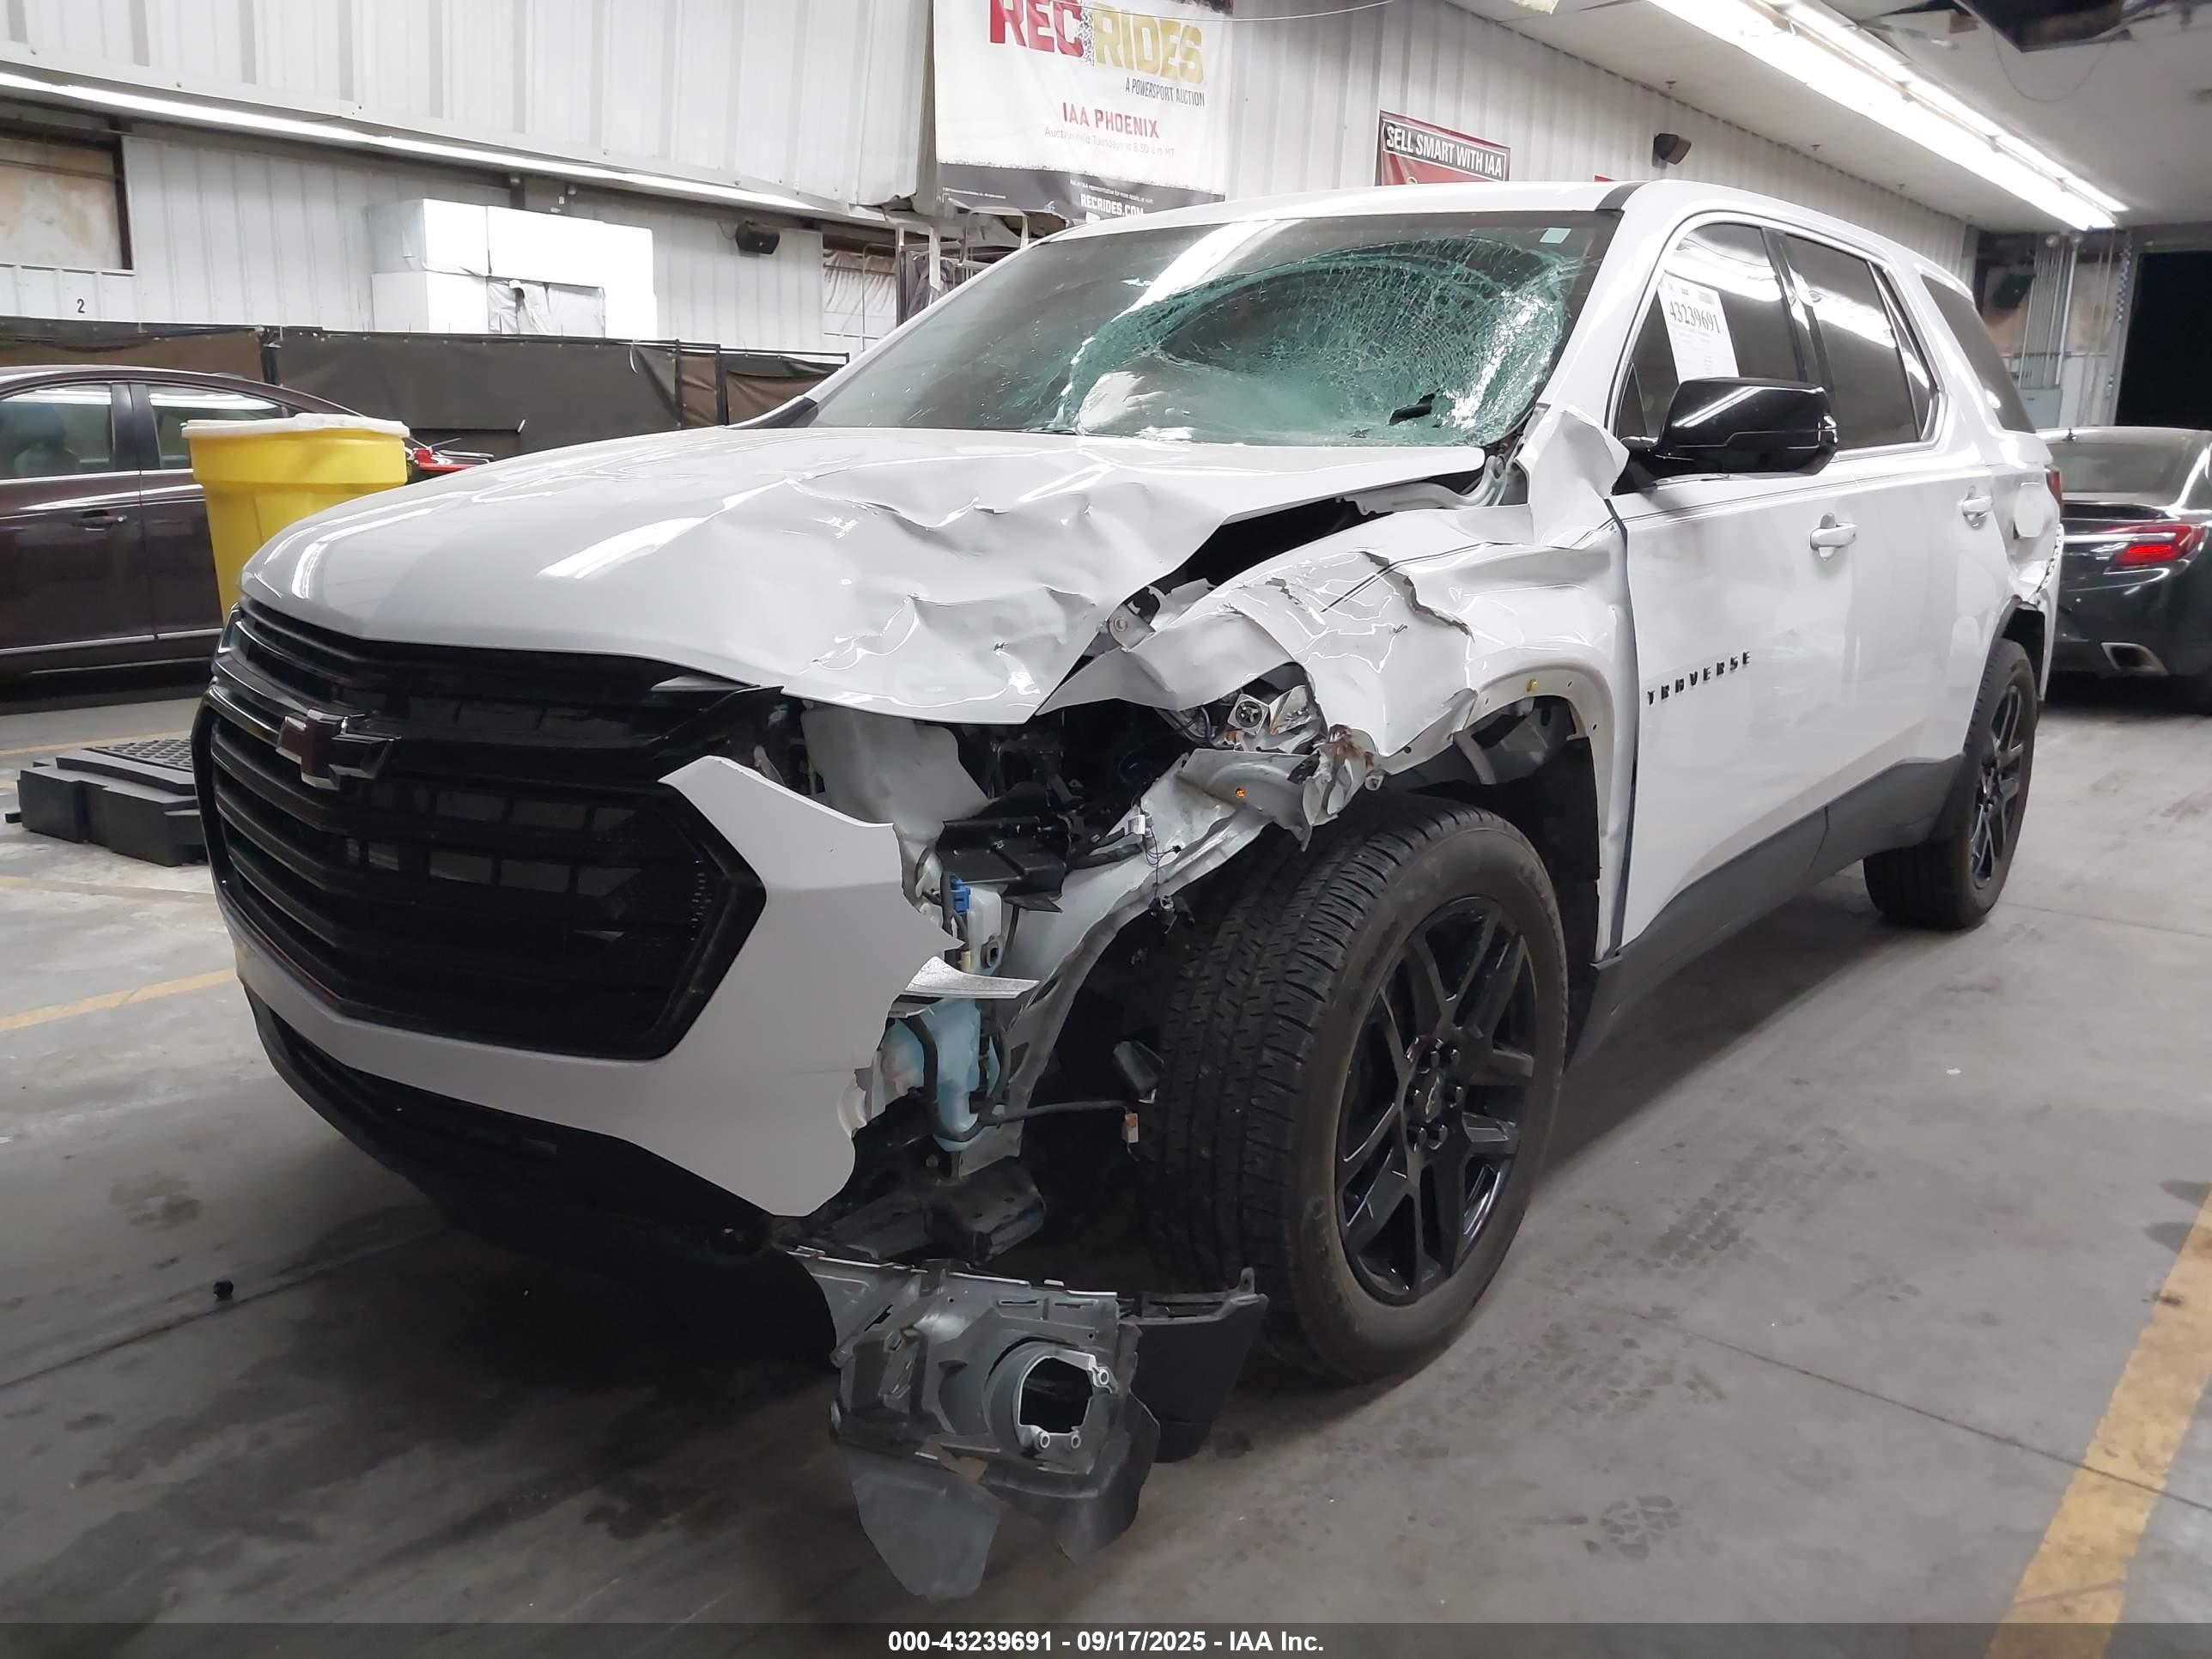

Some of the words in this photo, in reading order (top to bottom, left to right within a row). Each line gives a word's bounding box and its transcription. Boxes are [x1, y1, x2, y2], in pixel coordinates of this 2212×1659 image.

[1126, 77, 1131, 93] A
[1132, 80, 1174, 102] POWERSPORT
[1176, 88, 1205, 107] AUCTION
[1062, 101, 1090, 127] IAA
[1095, 108, 1160, 139] PHOENIX
[1386, 125, 1413, 154] SELL
[1415, 134, 1455, 164] SMART
[1455, 144, 1483, 173] WITH
[1484, 153, 1502, 178] IAA
[76, 298, 86, 314] 2
[1669, 300, 1721, 334] 43239691
[1647, 651, 1751, 706] TRAVERSE
